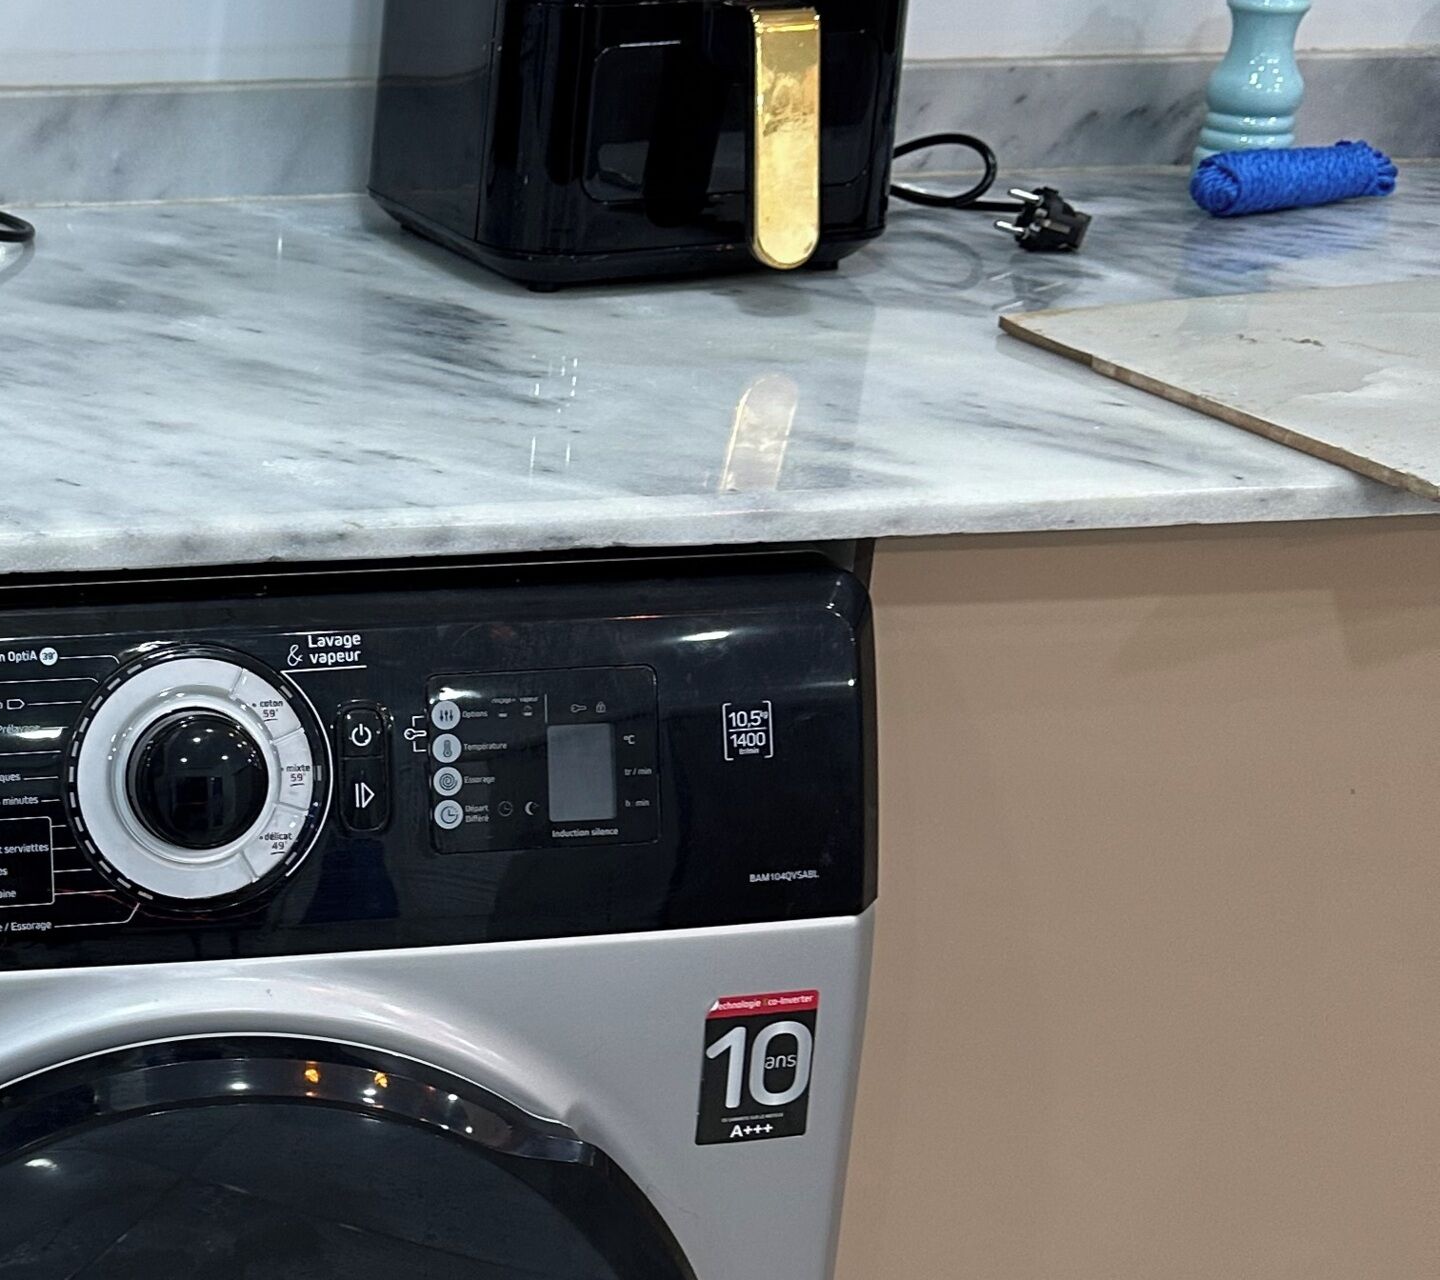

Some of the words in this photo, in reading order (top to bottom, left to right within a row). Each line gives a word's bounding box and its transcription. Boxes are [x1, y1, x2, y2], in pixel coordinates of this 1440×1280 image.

[308, 634, 361, 648] Lavage
[7, 650, 38, 663] OptiA
[309, 651, 361, 665] vapeur
[259, 700, 283, 708] coton
[462, 710, 488, 718] Options
[623, 734, 635, 744] °C
[730, 732, 766, 748] 1400
[286, 764, 311, 772] mixte
[2, 796, 39, 806] minutes
[264, 832, 293, 841] délicat
[552, 829, 590, 838] Induction
[591, 827, 619, 836] silence
[4, 843, 49, 854] serviettes
[10, 921, 52, 932] Essorage
[706, 1021, 813, 1108] 10
[764, 1055, 797, 1070] ans
[729, 1123, 774, 1138] A+++
